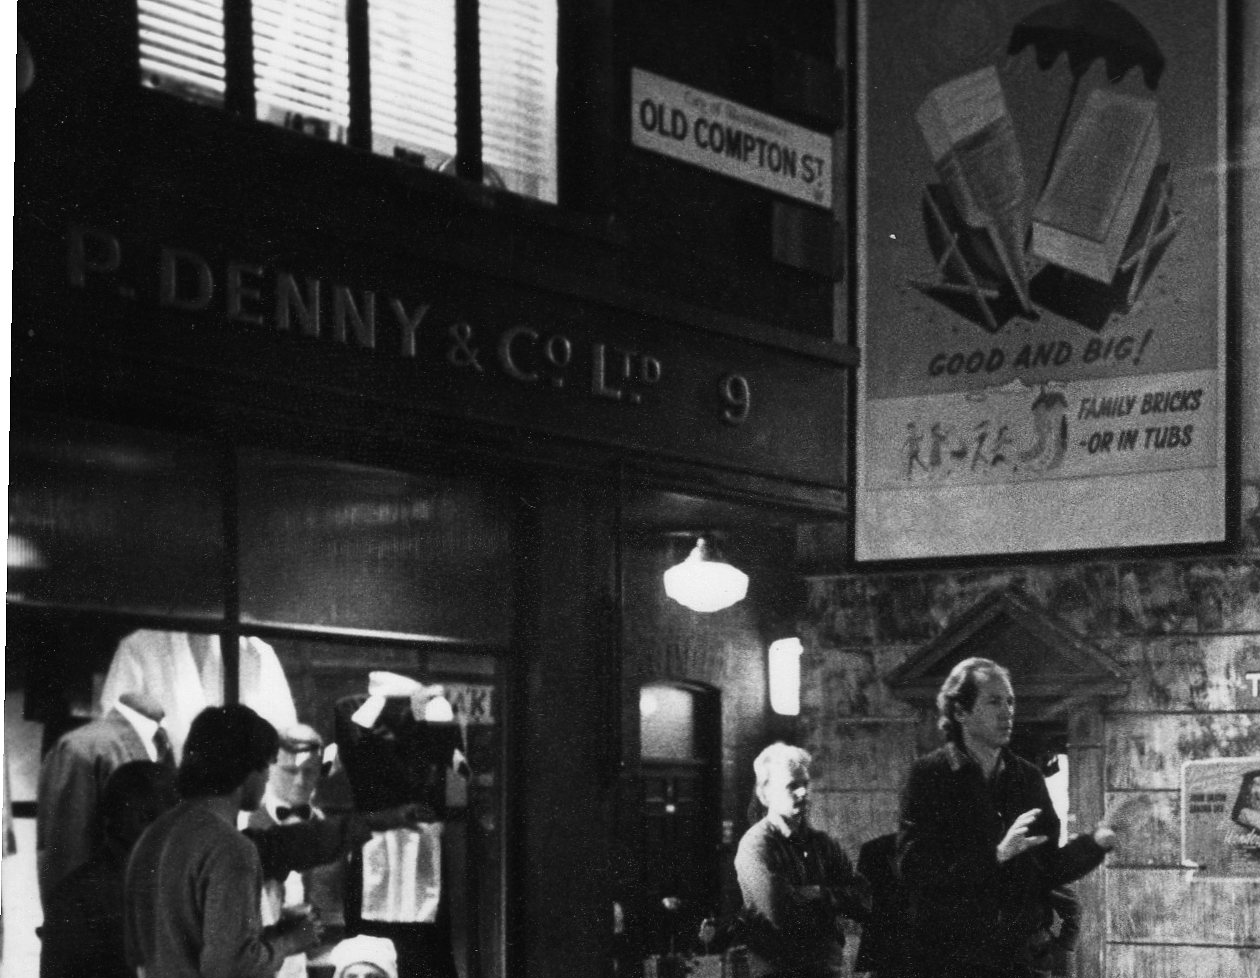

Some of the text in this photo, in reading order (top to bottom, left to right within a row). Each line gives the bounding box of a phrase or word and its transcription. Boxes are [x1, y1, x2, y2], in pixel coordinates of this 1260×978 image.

[640, 100, 687, 140] OLD
[694, 118, 796, 178] COMPTON
[161, 249, 430, 355] DENNY
[450, 323, 483, 371] &
[722, 374, 750, 424] 9
[928, 328, 1154, 376] GOOD AND BIG!
[1078, 389, 1203, 420] FAMILY BRICKS
[1117, 429, 1138, 451] IN
[1143, 424, 1194, 449] TUBS
